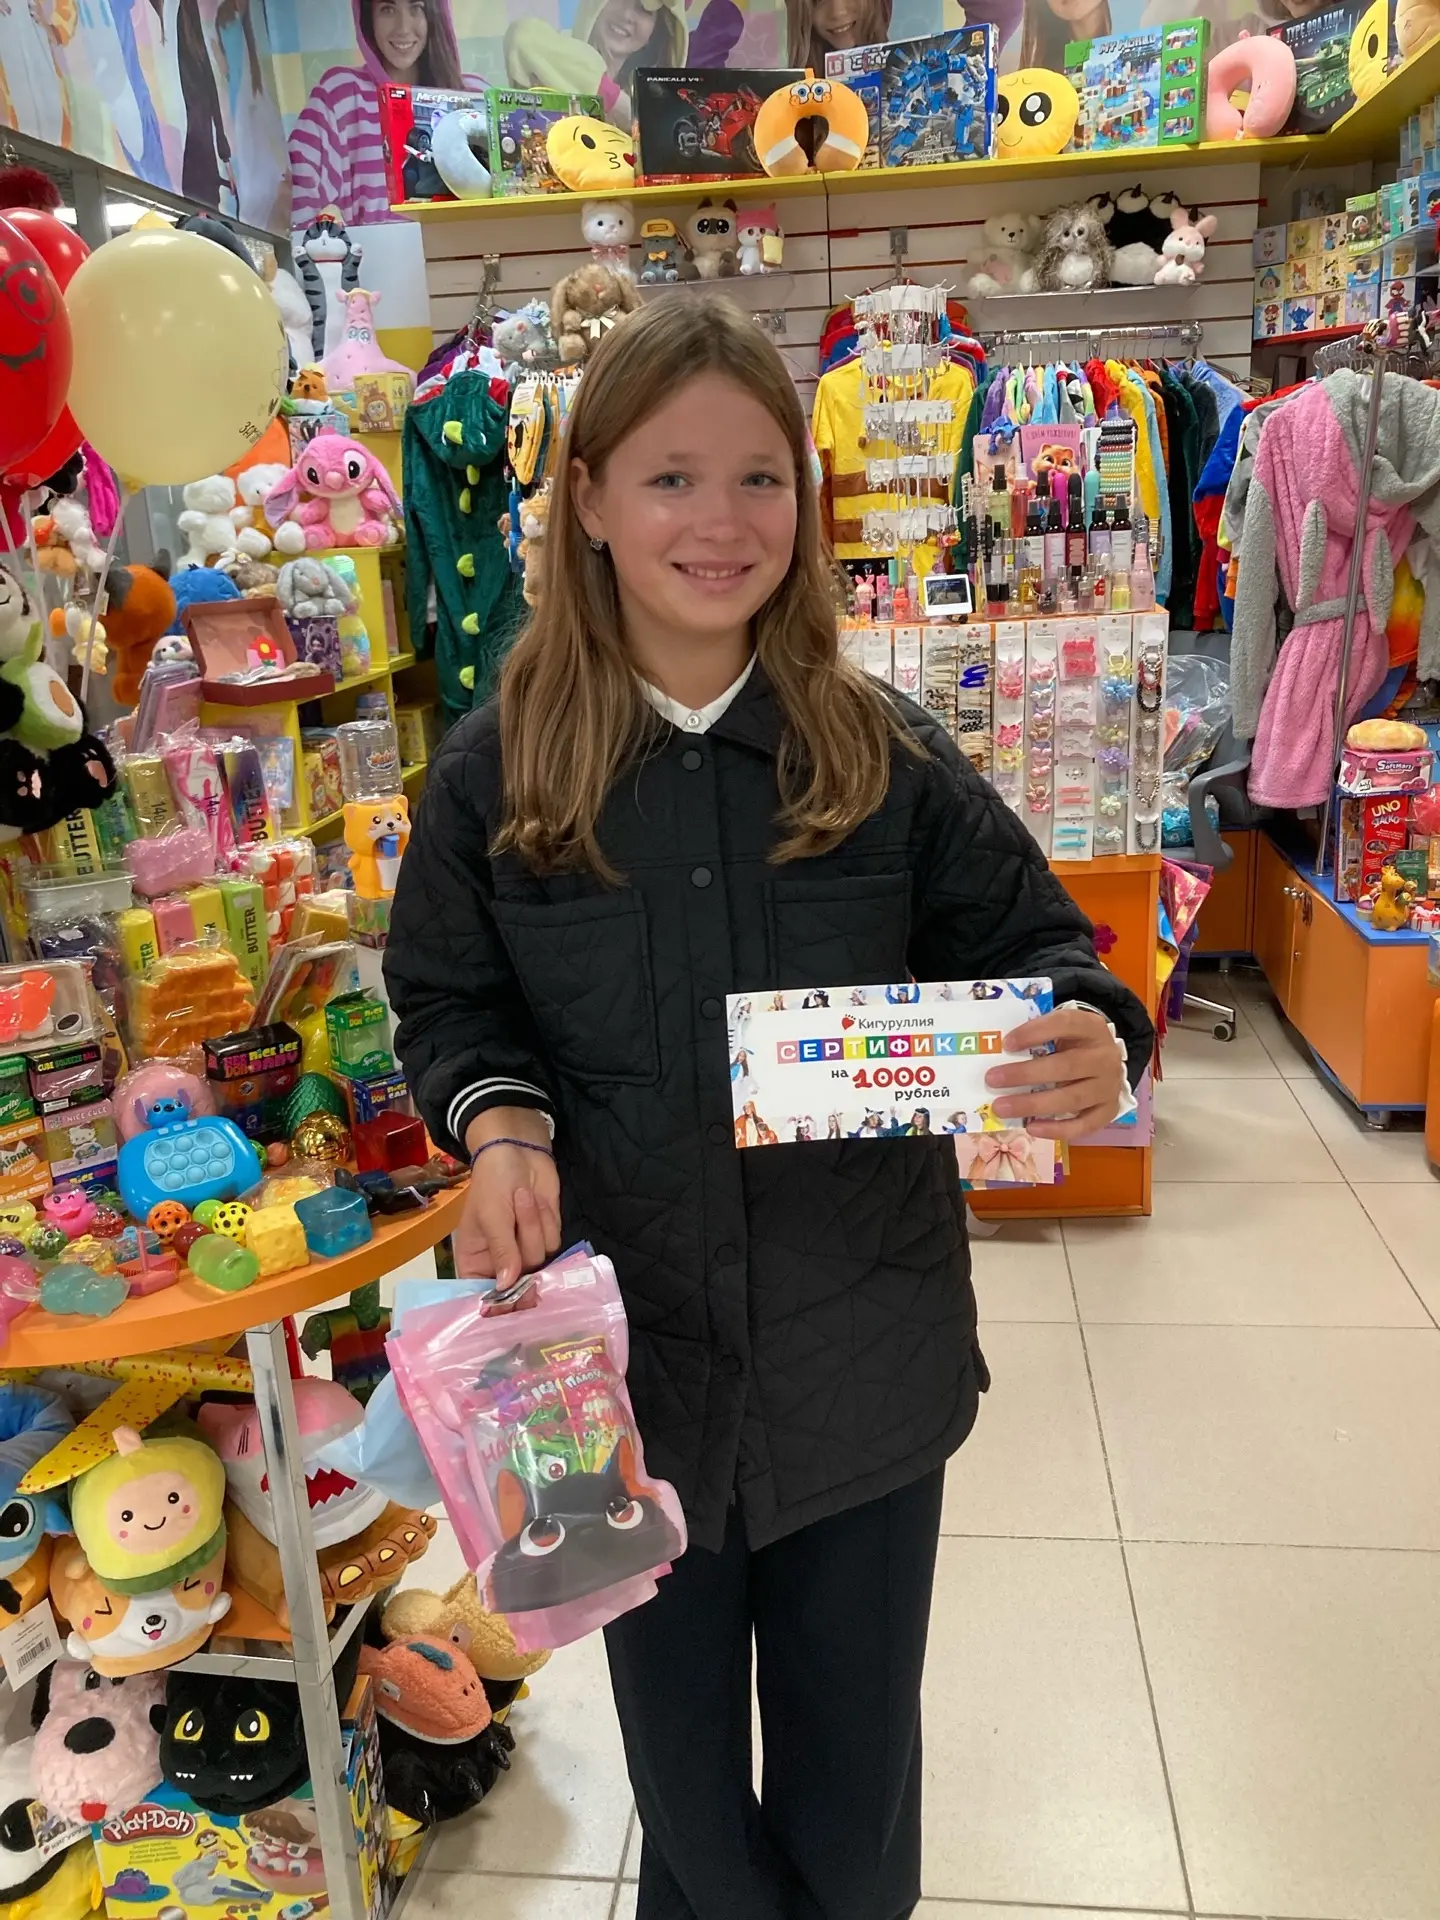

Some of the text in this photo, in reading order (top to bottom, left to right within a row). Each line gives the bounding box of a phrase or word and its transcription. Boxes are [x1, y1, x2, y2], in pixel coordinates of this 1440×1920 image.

[1323, 8, 1344, 28] TANK
[1119, 33, 1157, 50] WORLD
[1371, 799, 1401, 817] UNO
[244, 907, 259, 955] BUTTER
[858, 1017, 934, 1032] Кигуруллия
[779, 1034, 999, 1061] СЕРТИФИКАТ
[37, 1061, 54, 1072] CUBE
[831, 1066, 936, 1089] на 1000
[894, 1086, 950, 1101] рублей
[0, 1098, 21, 1117] prite
